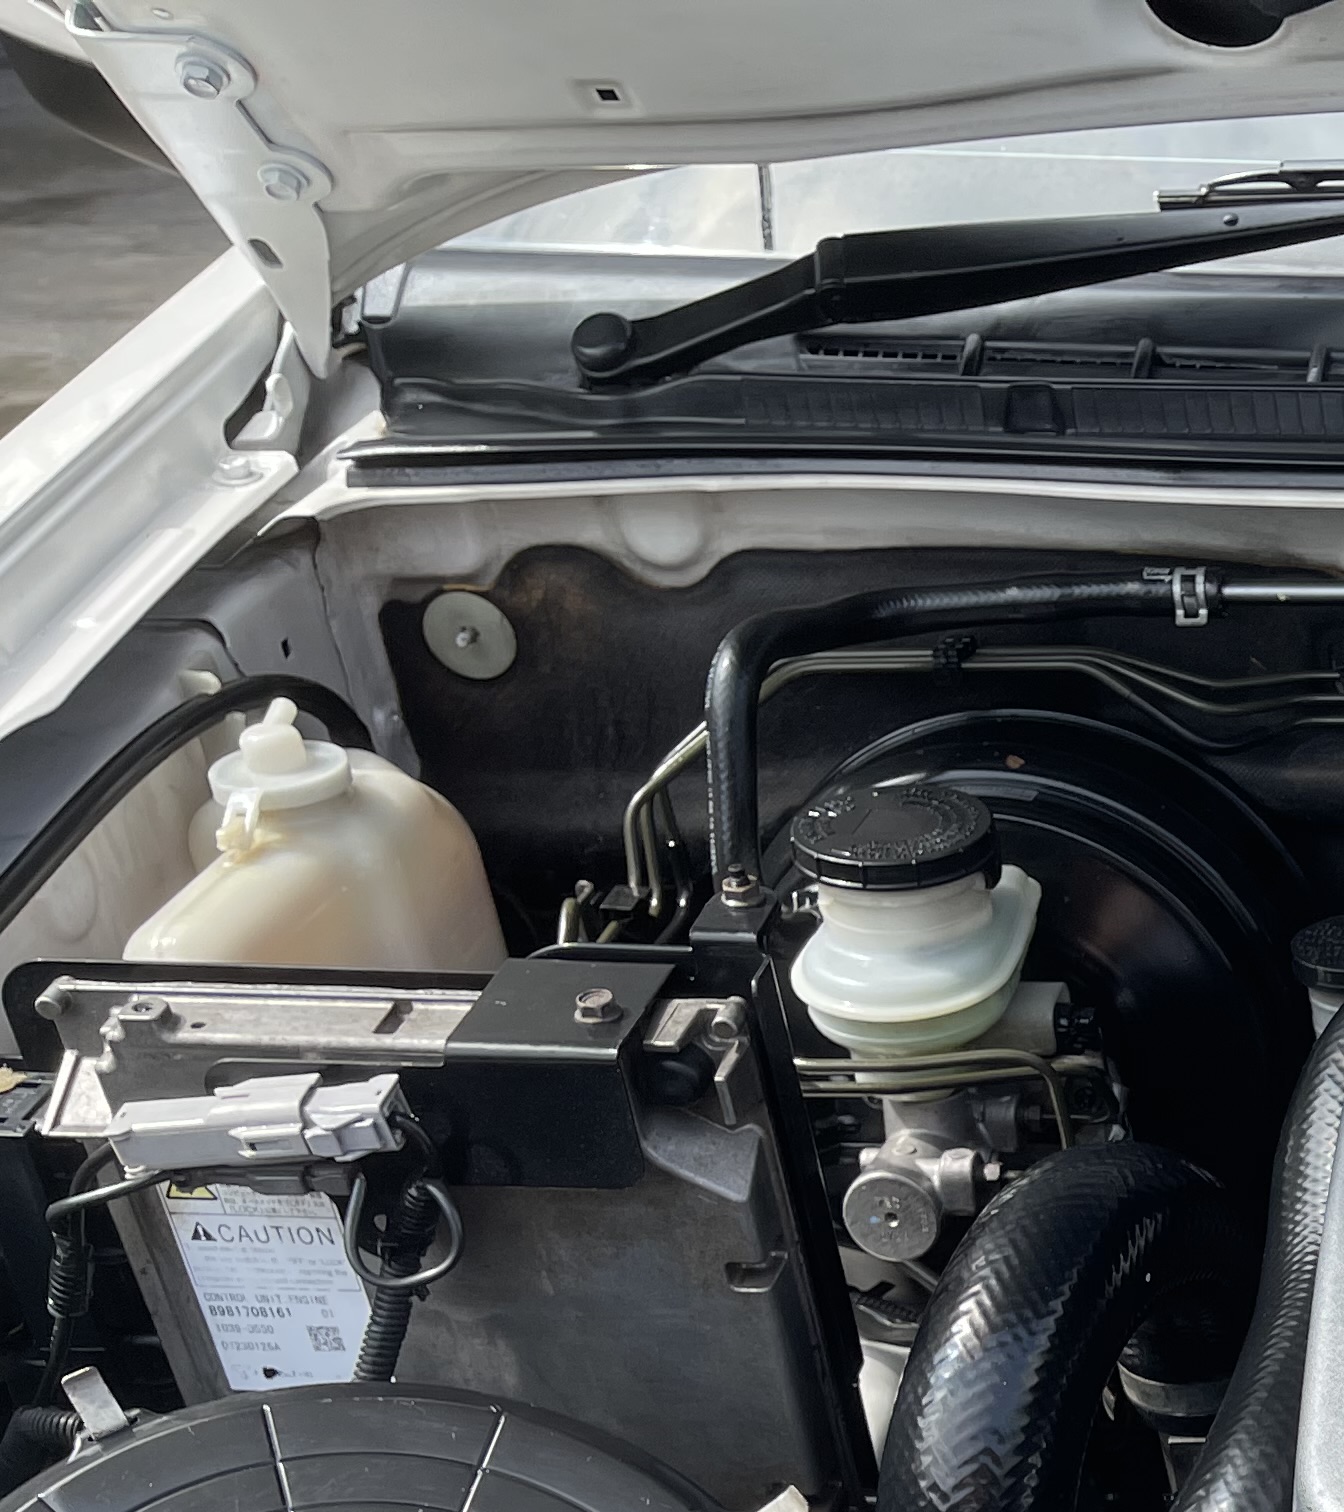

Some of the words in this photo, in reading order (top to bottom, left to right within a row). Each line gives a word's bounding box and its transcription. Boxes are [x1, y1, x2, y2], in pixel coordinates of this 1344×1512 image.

[217, 1223, 336, 1246] CAUTION
[203, 1291, 246, 1303] CONTROL
[254, 1293, 281, 1304] UNIT
